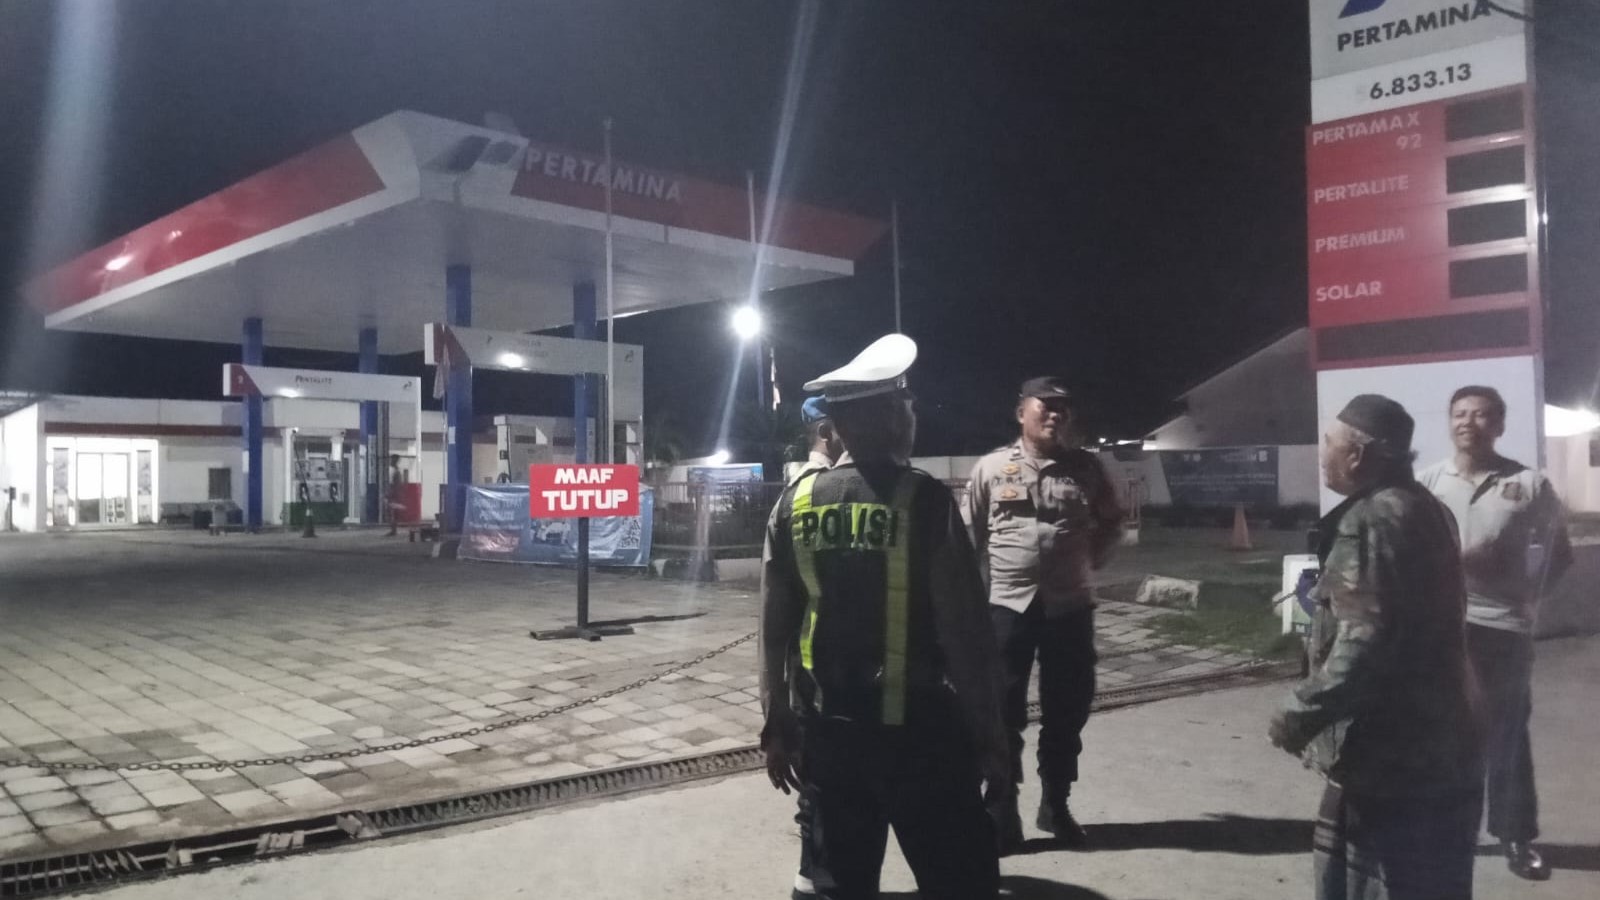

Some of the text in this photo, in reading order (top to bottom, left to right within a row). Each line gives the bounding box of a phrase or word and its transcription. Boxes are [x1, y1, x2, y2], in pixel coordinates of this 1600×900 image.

[1337, 2, 1492, 51] PERTAMINA
[1369, 63, 1472, 100] 6.833.13
[1396, 134, 1422, 151] 92
[524, 148, 682, 201] PERTAMINA
[1314, 175, 1409, 204] PERTALITE
[1315, 227, 1405, 253] PREMIUM
[1316, 281, 1382, 302] SOLAR
[554, 467, 614, 484] MAAF
[542, 489, 629, 511] TUTUP
[801, 506, 899, 547] POLISI
